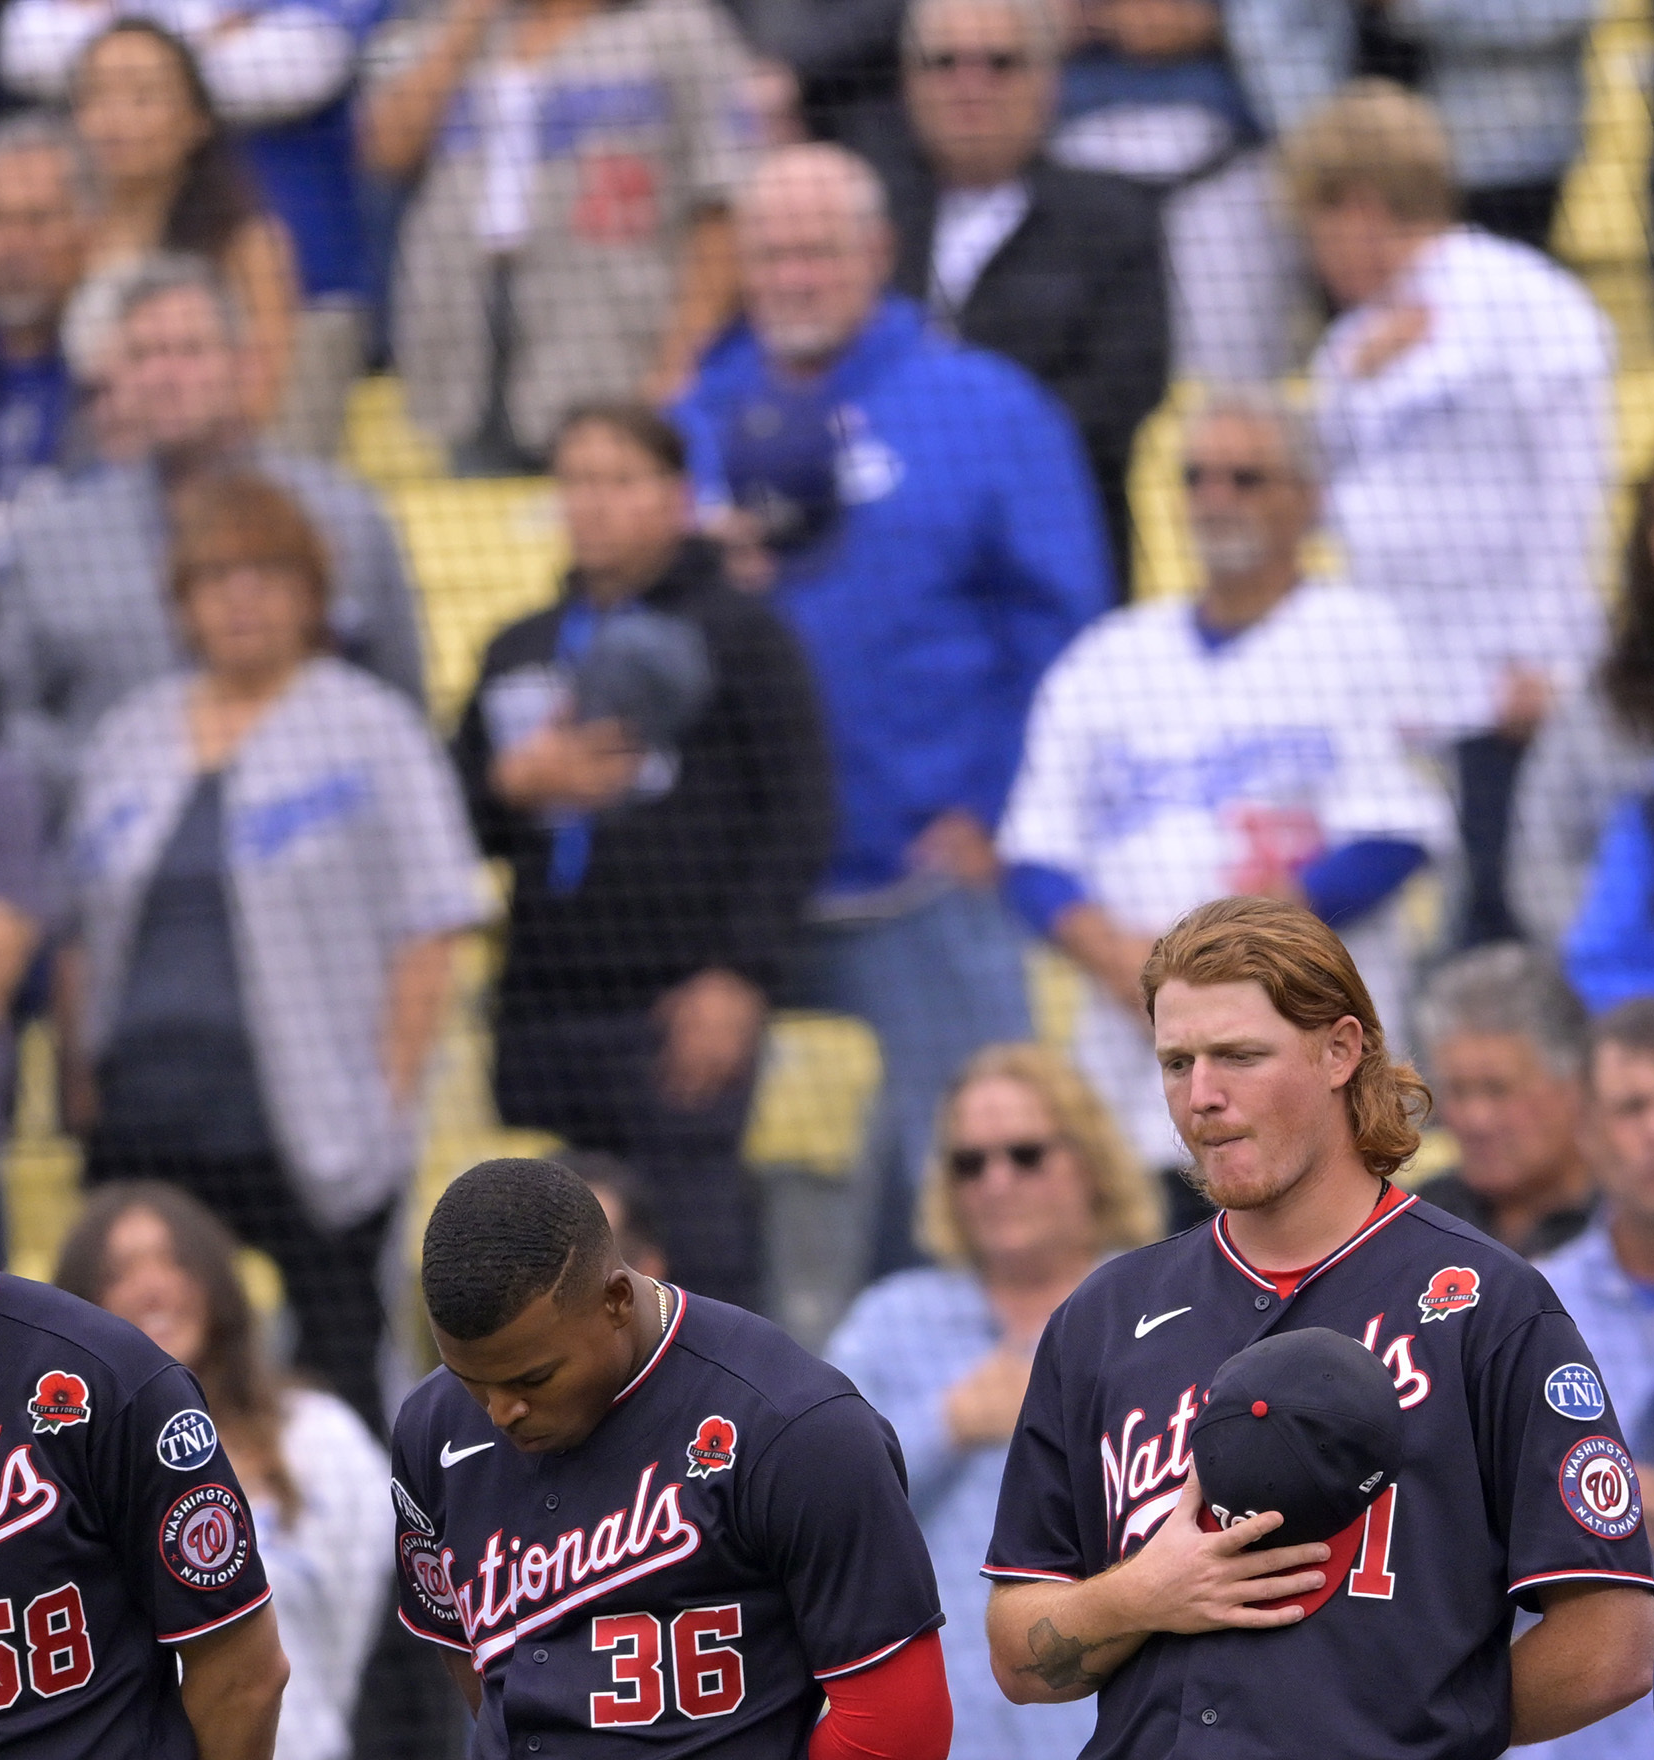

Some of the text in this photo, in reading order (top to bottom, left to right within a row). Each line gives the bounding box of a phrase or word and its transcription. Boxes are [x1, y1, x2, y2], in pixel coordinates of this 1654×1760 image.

[1450, 1294, 1474, 1302] FORGET
[32, 1404, 85, 1416] LEST WE FORGET
[1549, 1381, 1604, 1407] TNL
[161, 1421, 215, 1463] TNL
[690, 1447, 703, 1456] LEST
[711, 1452, 730, 1461] FORGET
[1564, 1440, 1634, 1479] WASHINGTON
[164, 1488, 239, 1542] WASHINGTON
[1575, 1504, 1640, 1535] NATIONALS
[1348, 1483, 1397, 1600] 1
[179, 1538, 247, 1587] NATIONALS
[590, 1602, 746, 1729] 36
